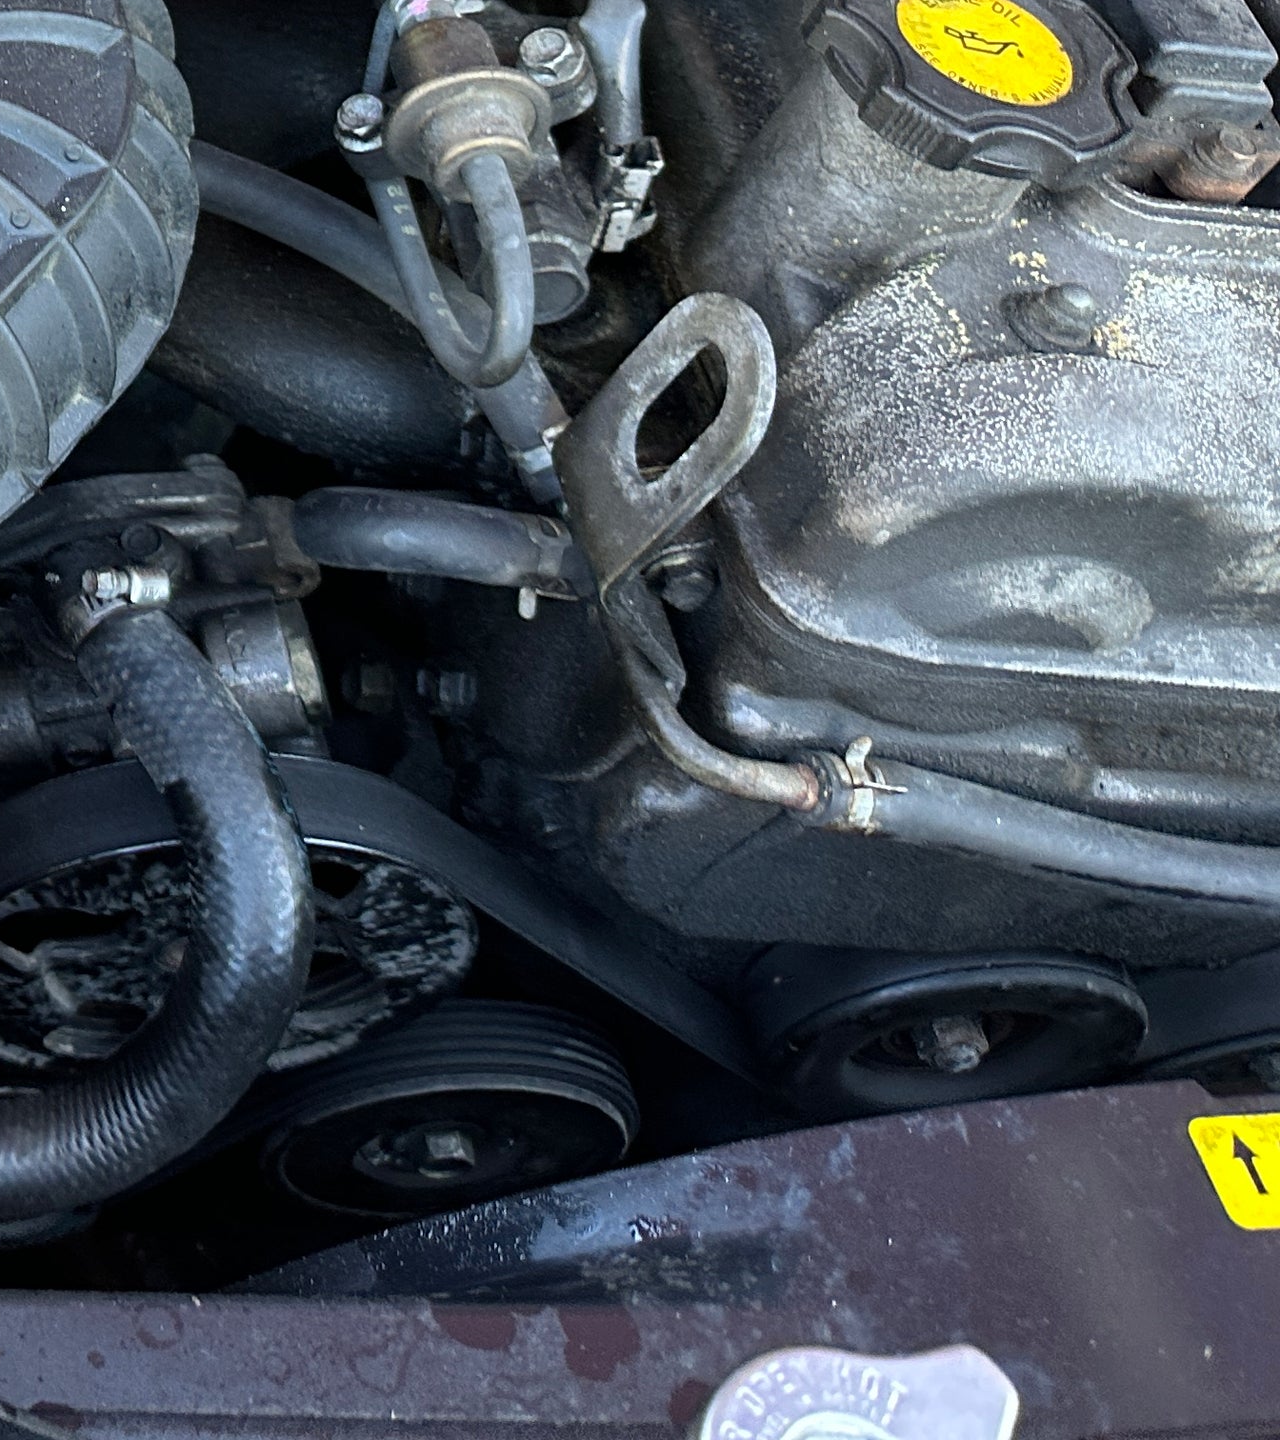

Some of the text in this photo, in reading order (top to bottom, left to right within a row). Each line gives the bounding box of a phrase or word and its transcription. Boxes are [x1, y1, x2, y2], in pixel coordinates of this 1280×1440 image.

[991, 0, 1024, 28] OIL
[914, 42, 942, 66] SEE
[947, 69, 1022, 103] OWNER'S
